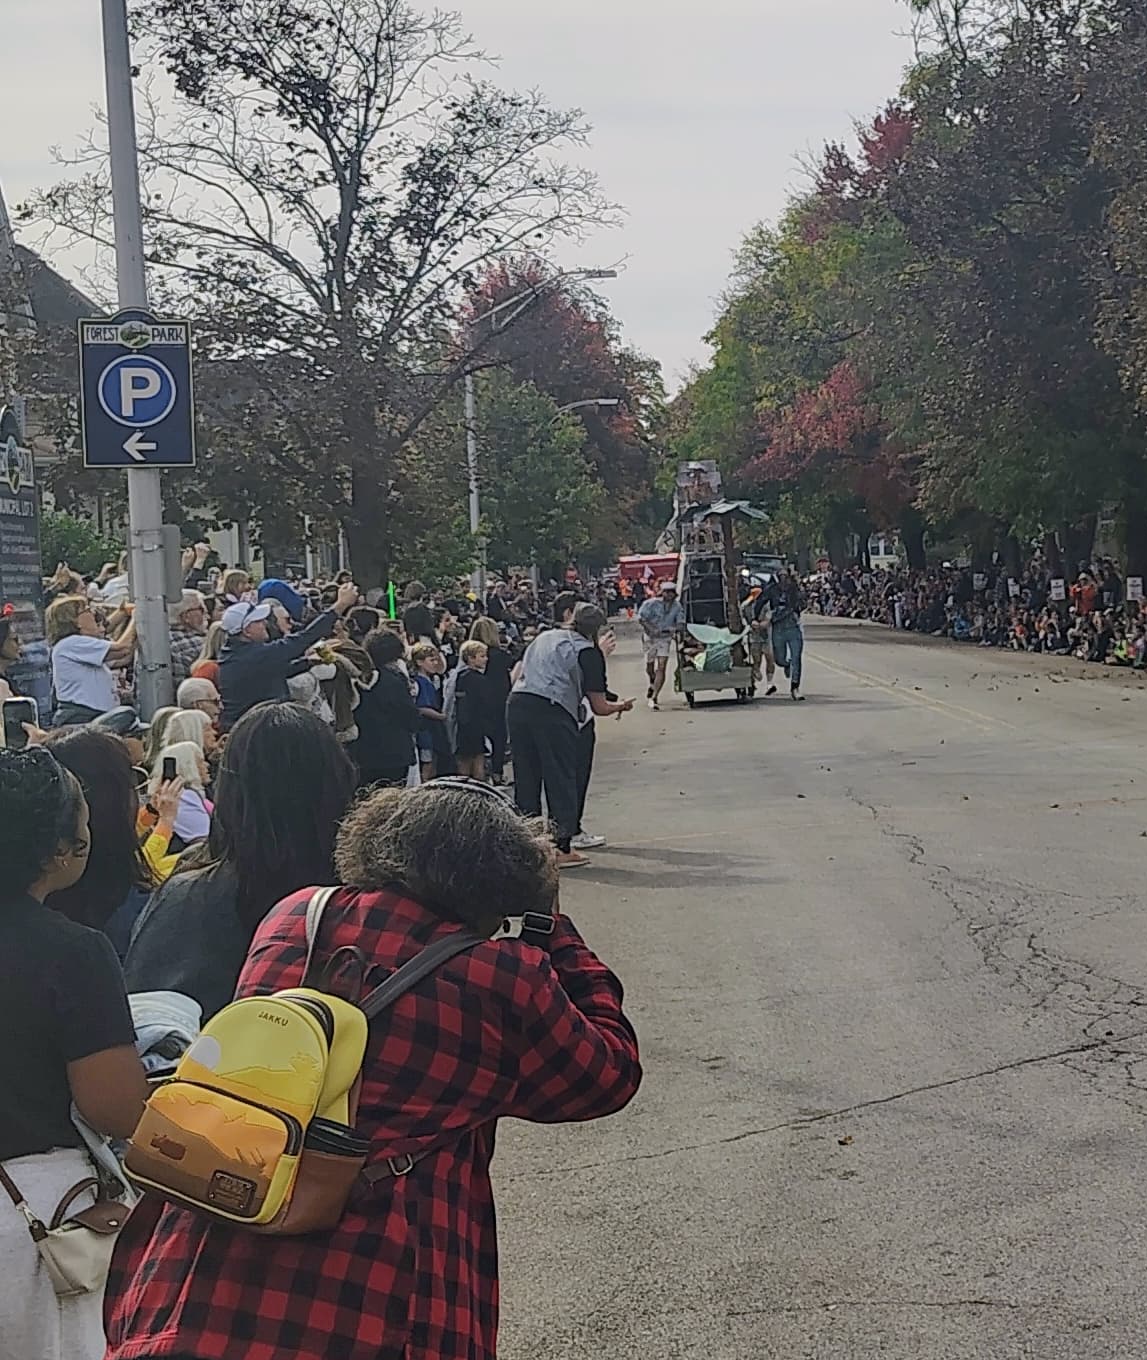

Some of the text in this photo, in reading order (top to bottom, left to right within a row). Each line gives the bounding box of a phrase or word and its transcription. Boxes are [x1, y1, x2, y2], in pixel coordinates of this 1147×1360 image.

[86, 326, 184, 342] FOREST PARK
[120, 367, 161, 417] P
[257, 1011, 289, 1027] JAKKU
